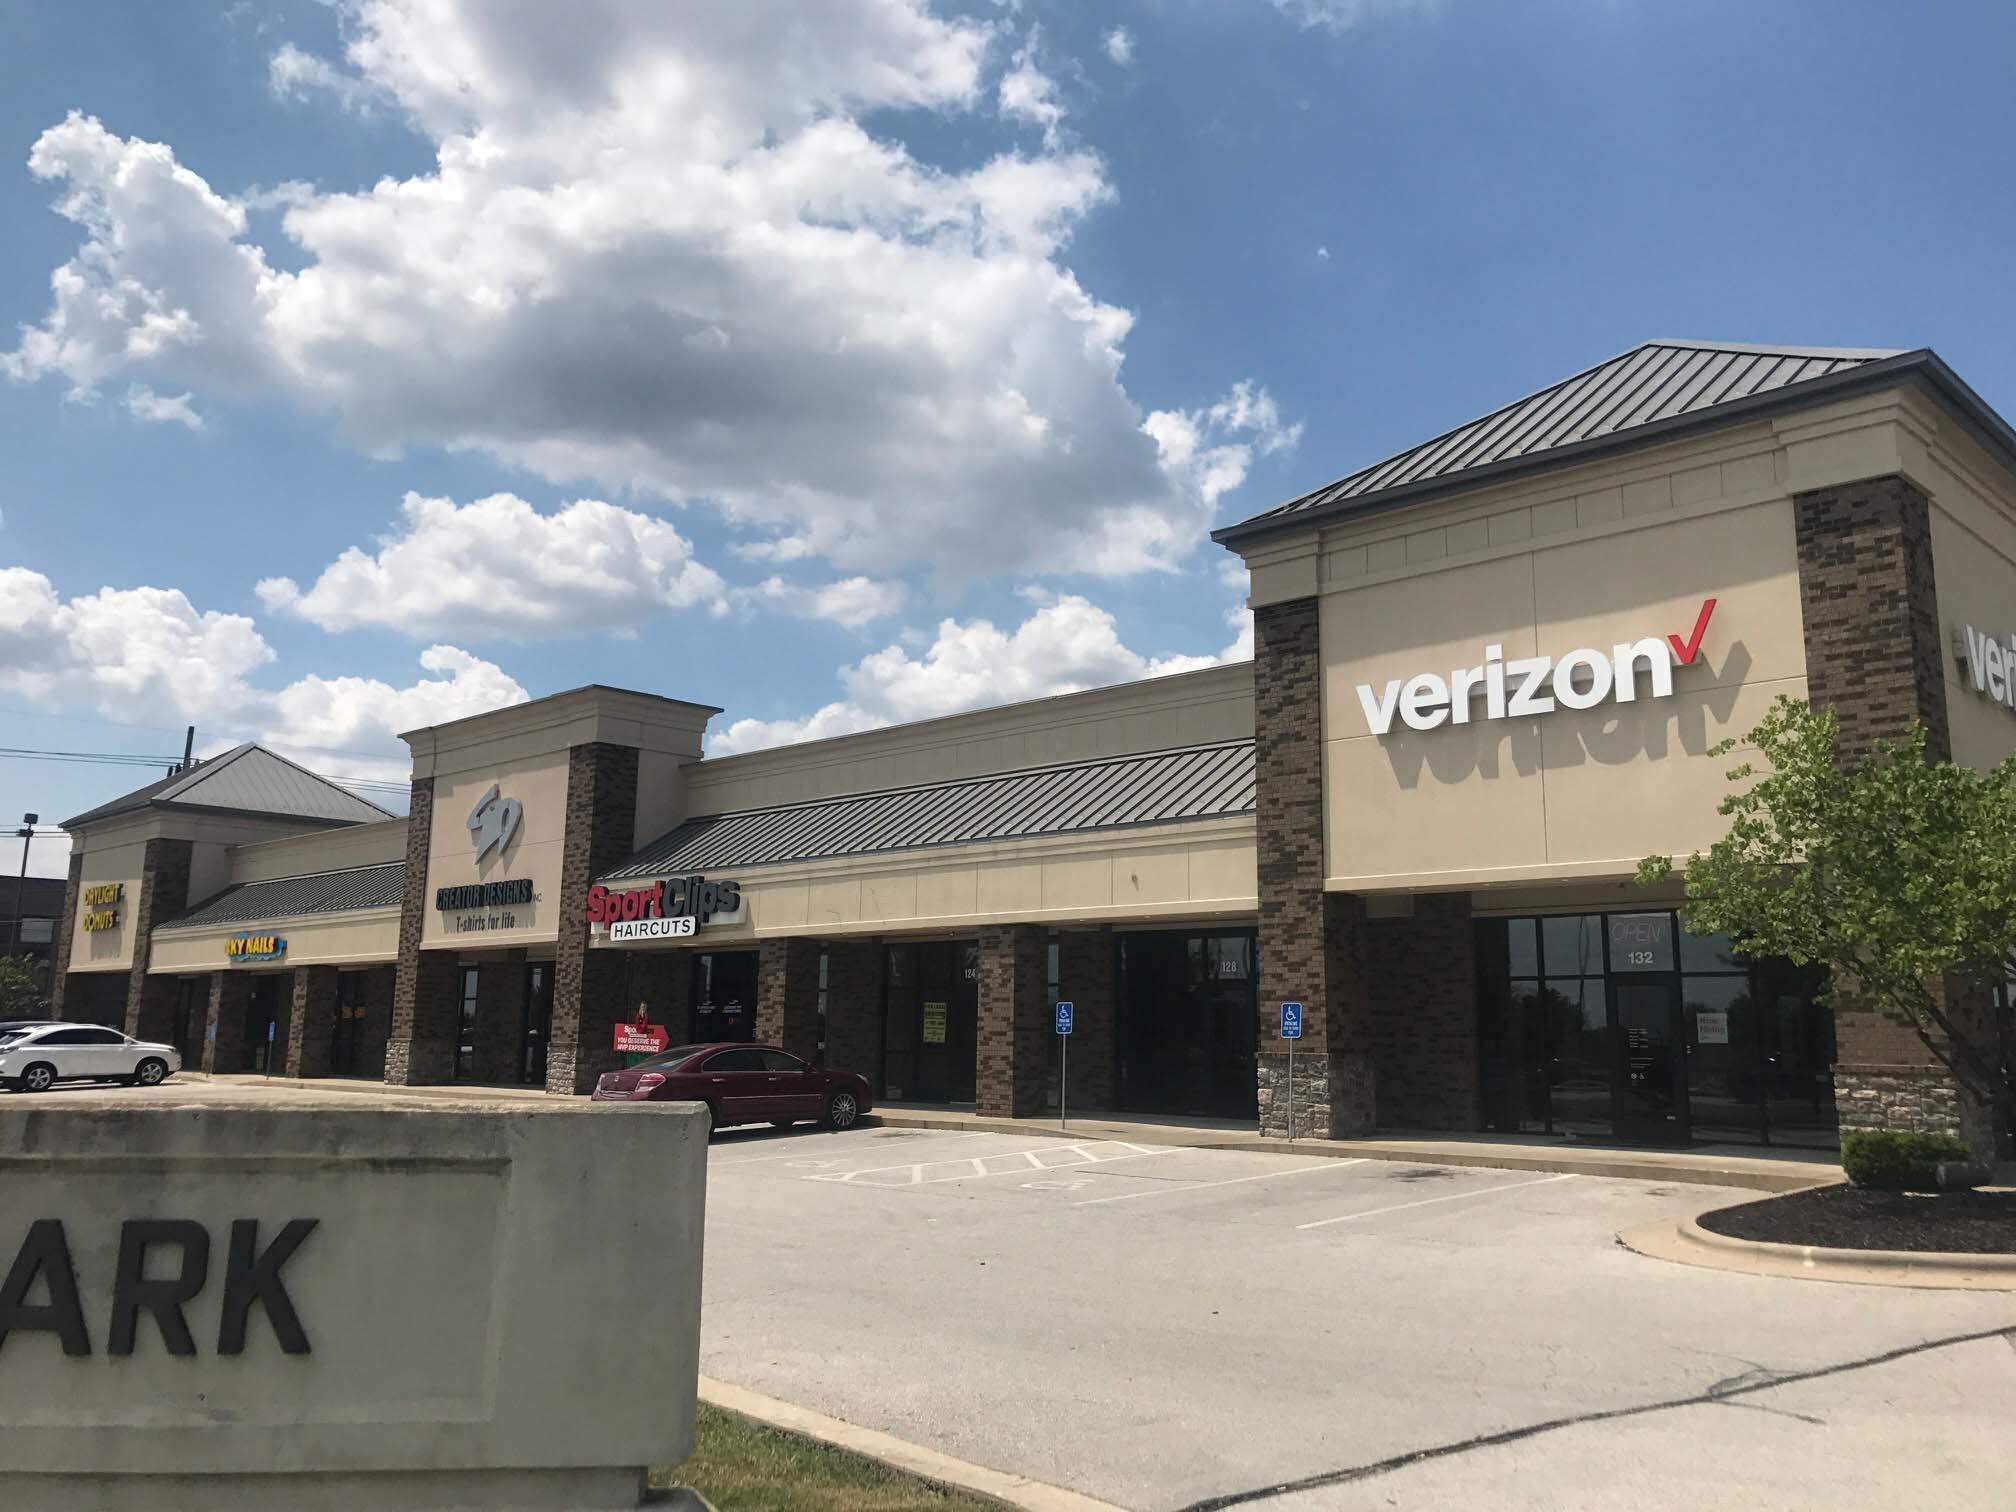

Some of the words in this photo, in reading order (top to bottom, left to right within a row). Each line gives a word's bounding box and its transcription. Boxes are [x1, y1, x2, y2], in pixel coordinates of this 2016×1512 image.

[1356, 636, 1673, 735] verizon
[437, 885, 481, 911] CREATOR
[483, 879, 533, 906] DESIGNS
[82, 910, 113, 931] DONUTS
[456, 914, 486, 933] T-shirts
[487, 913, 500, 930] for
[501, 911, 516, 929] life
[614, 918, 691, 938] HAIRCUTS
[245, 936, 275, 954] NAILS
[1222, 960, 1237, 973] 128
[1628, 951, 1654, 964] 132
[650, 1038, 661, 1046] THE
[0, 1218, 320, 1355] ARK
